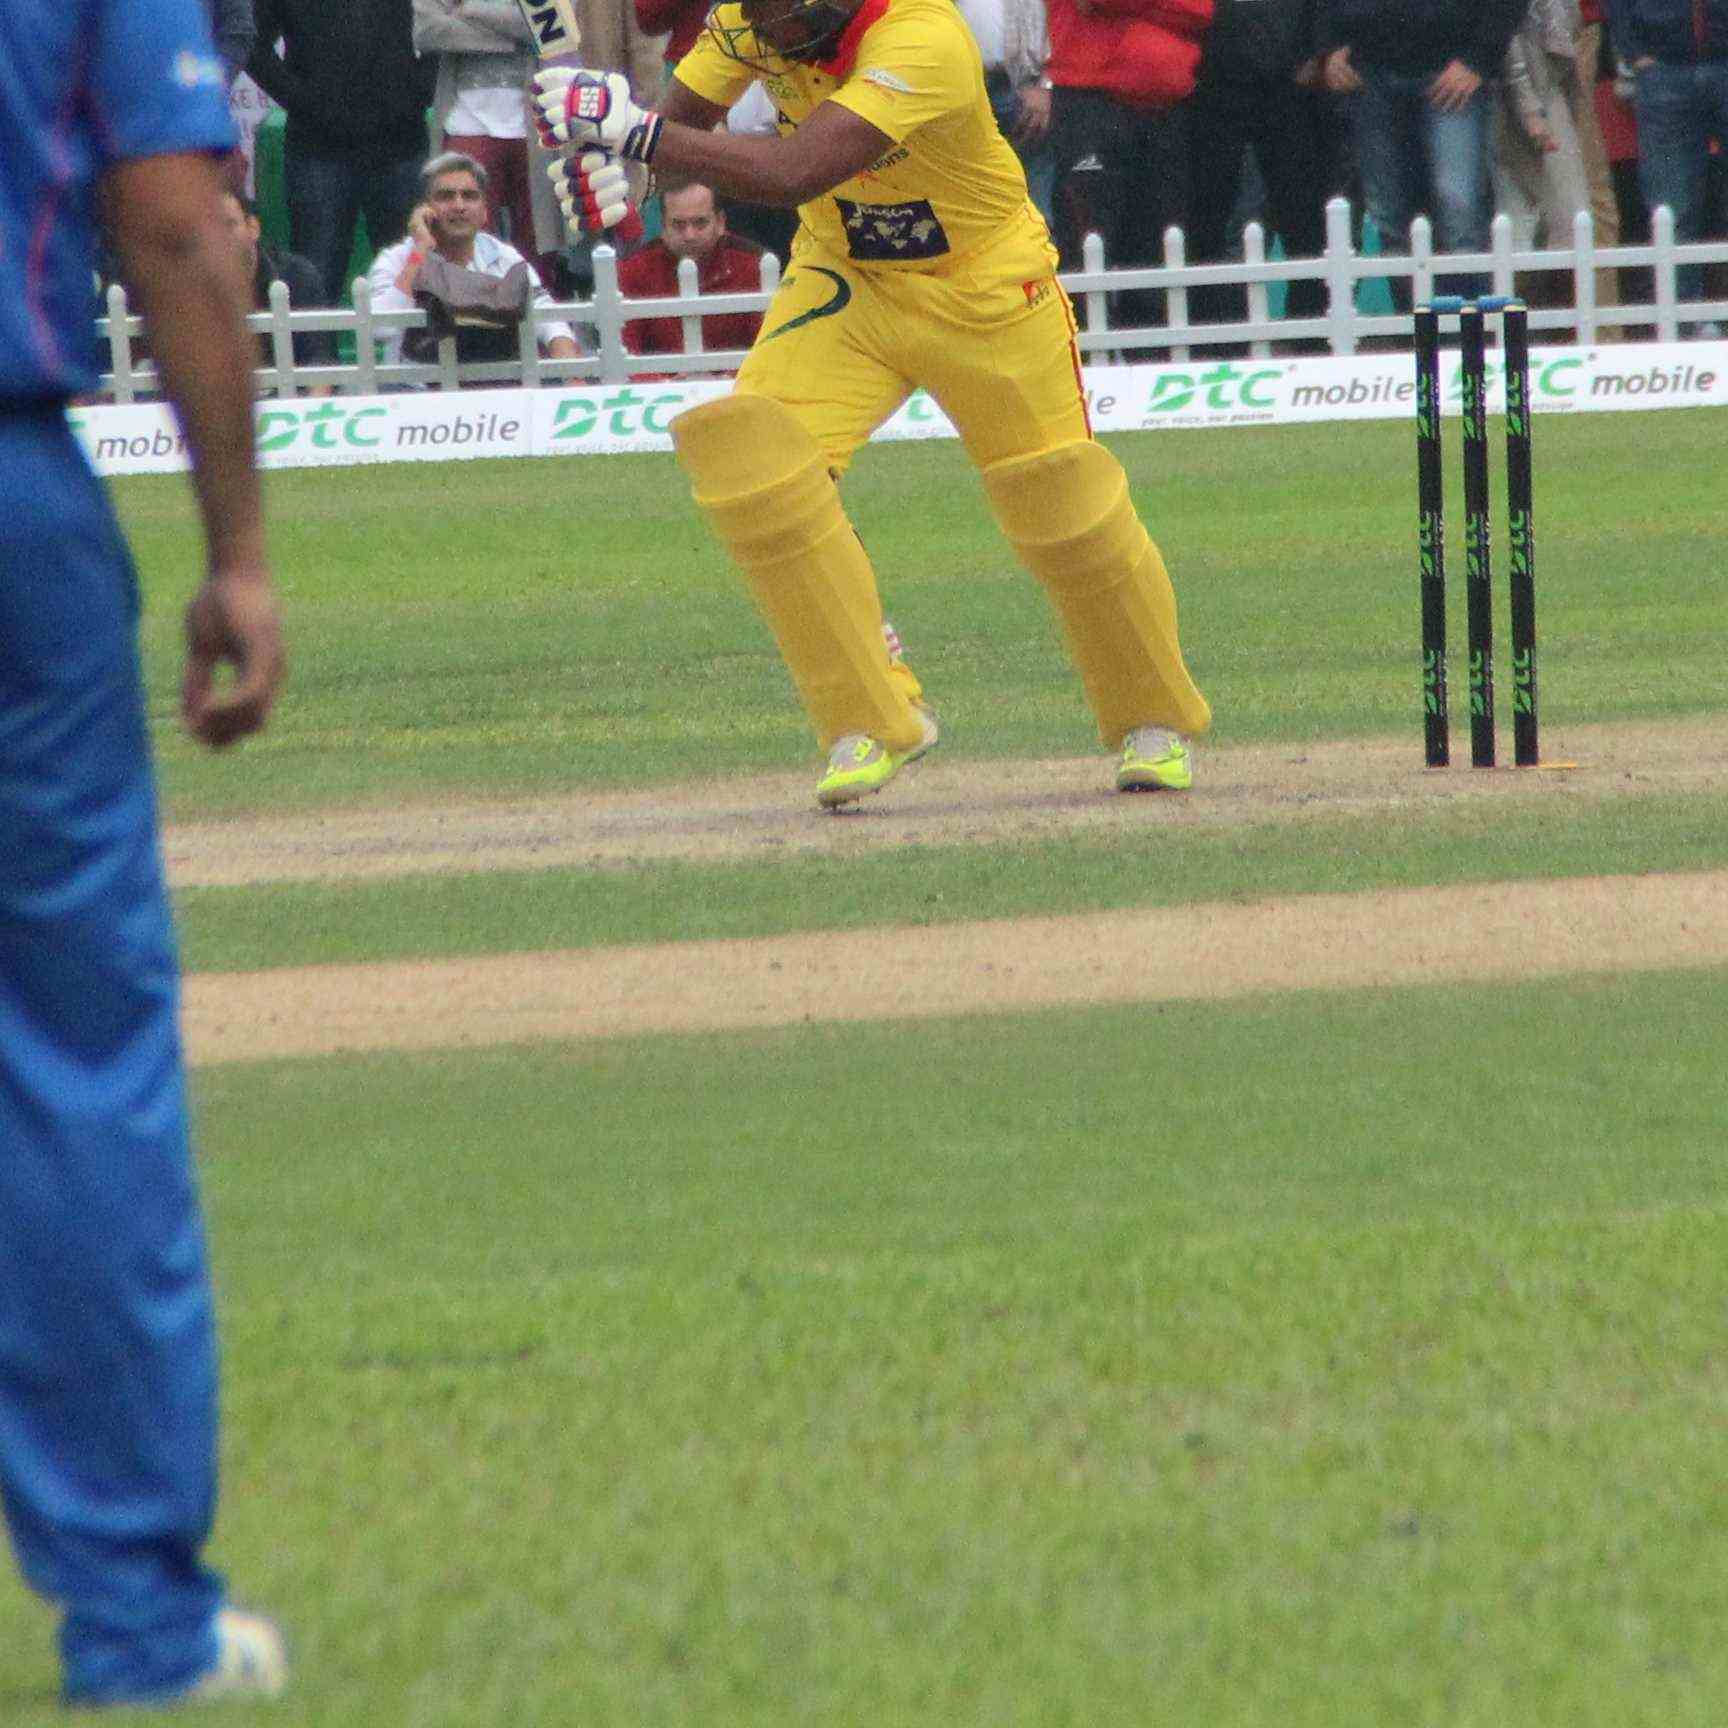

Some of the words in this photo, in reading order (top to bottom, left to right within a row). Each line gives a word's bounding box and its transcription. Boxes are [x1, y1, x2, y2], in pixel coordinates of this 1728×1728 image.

[1291, 376, 1415, 407] mobile
[1591, 365, 1716, 397] mobile
[396, 413, 521, 448] mobile
